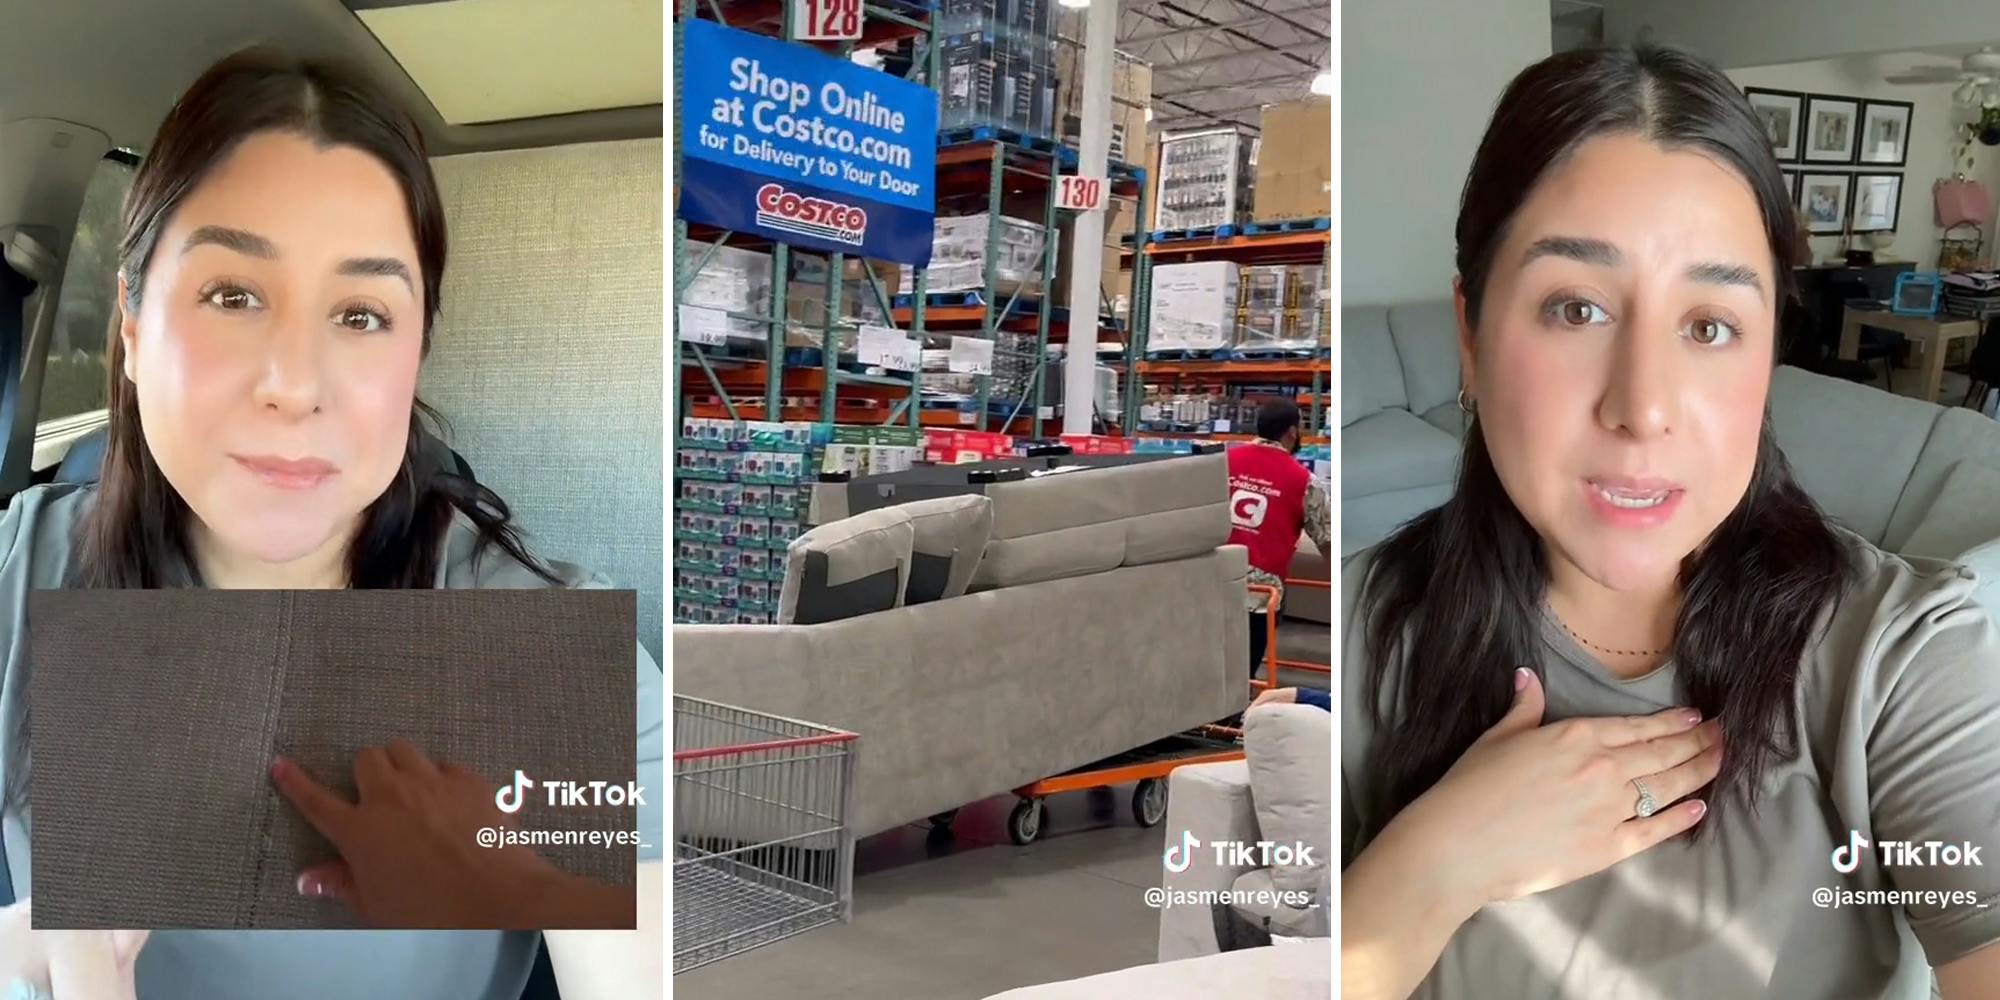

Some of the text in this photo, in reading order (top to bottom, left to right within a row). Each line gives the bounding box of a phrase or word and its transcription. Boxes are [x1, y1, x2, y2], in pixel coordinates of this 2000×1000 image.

[806, 0, 861, 36] 128
[729, 56, 906, 134] Shop Online
[711, 97, 912, 169] at Costco.com
[699, 124, 920, 197] for Delivery to Your Door
[756, 183, 867, 232] COSTCO
[1062, 177, 1100, 208] 130
[1228, 476, 1281, 498] Costco.com
